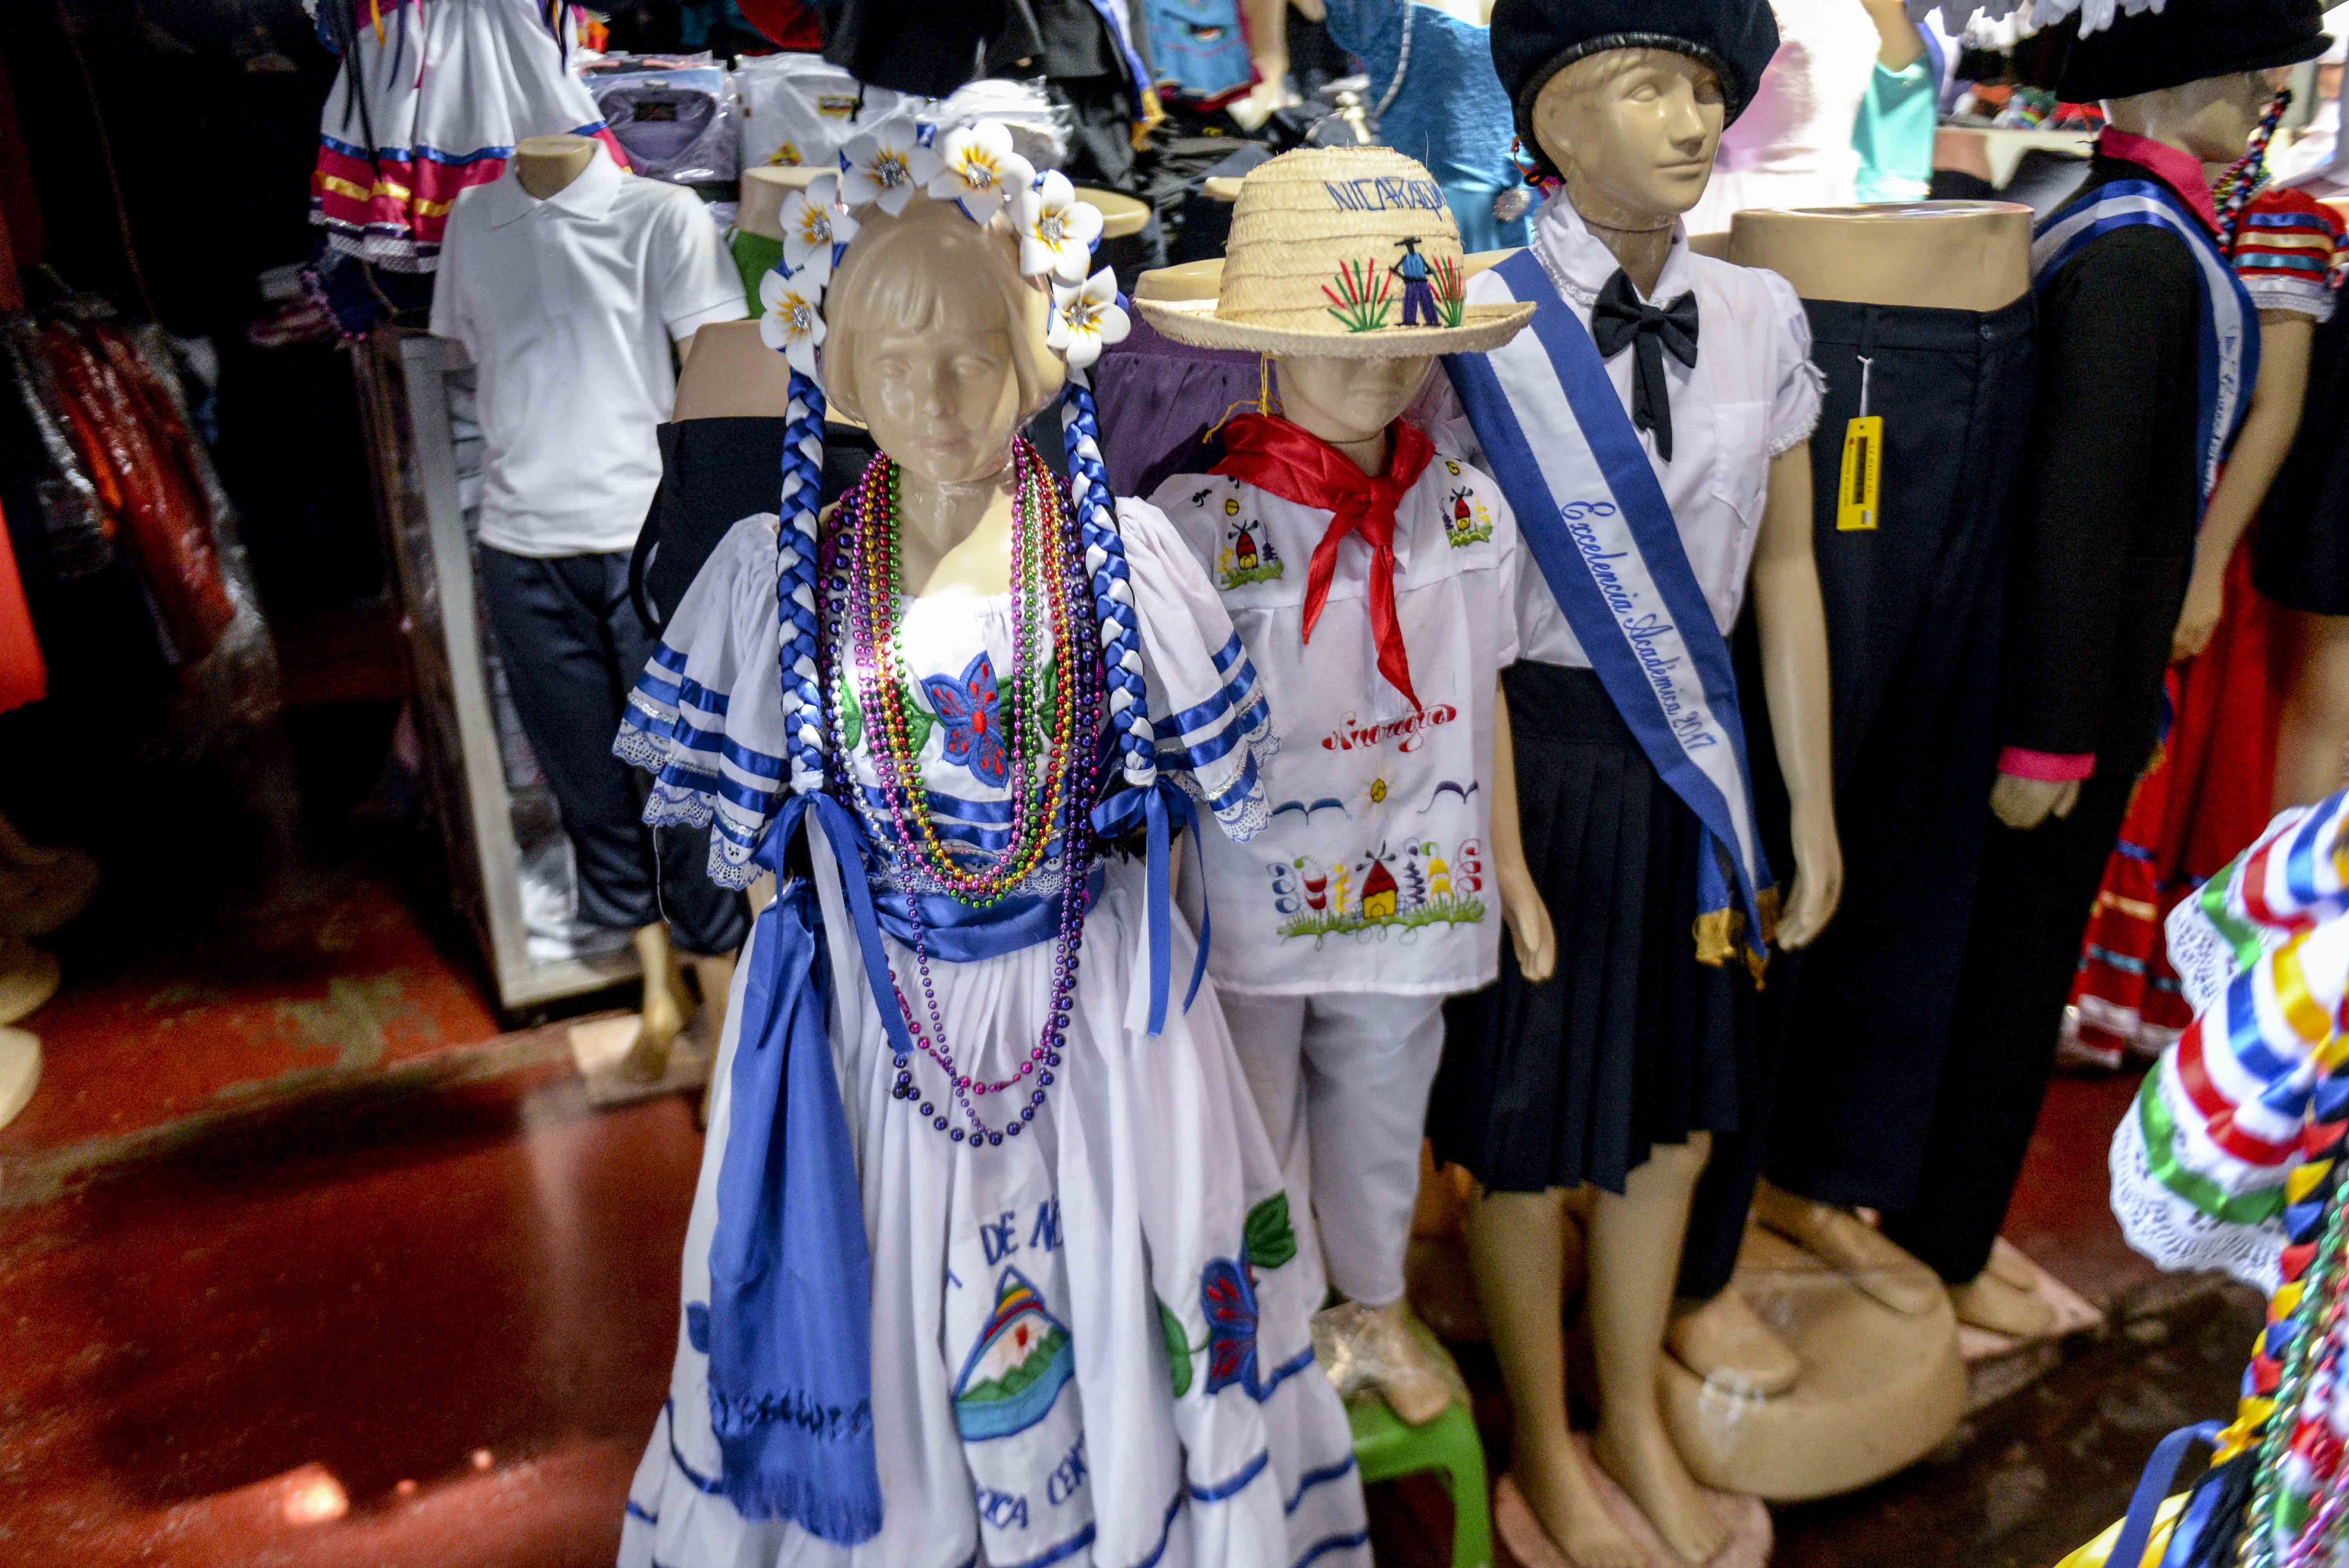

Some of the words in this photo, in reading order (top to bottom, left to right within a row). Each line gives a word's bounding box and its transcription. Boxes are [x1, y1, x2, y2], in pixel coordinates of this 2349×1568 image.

[1562, 501, 1638, 613] Excelencia
[1623, 612, 1684, 715] Académica
[1671, 711, 1716, 750] 2017
[980, 1210, 1018, 1266] DE
